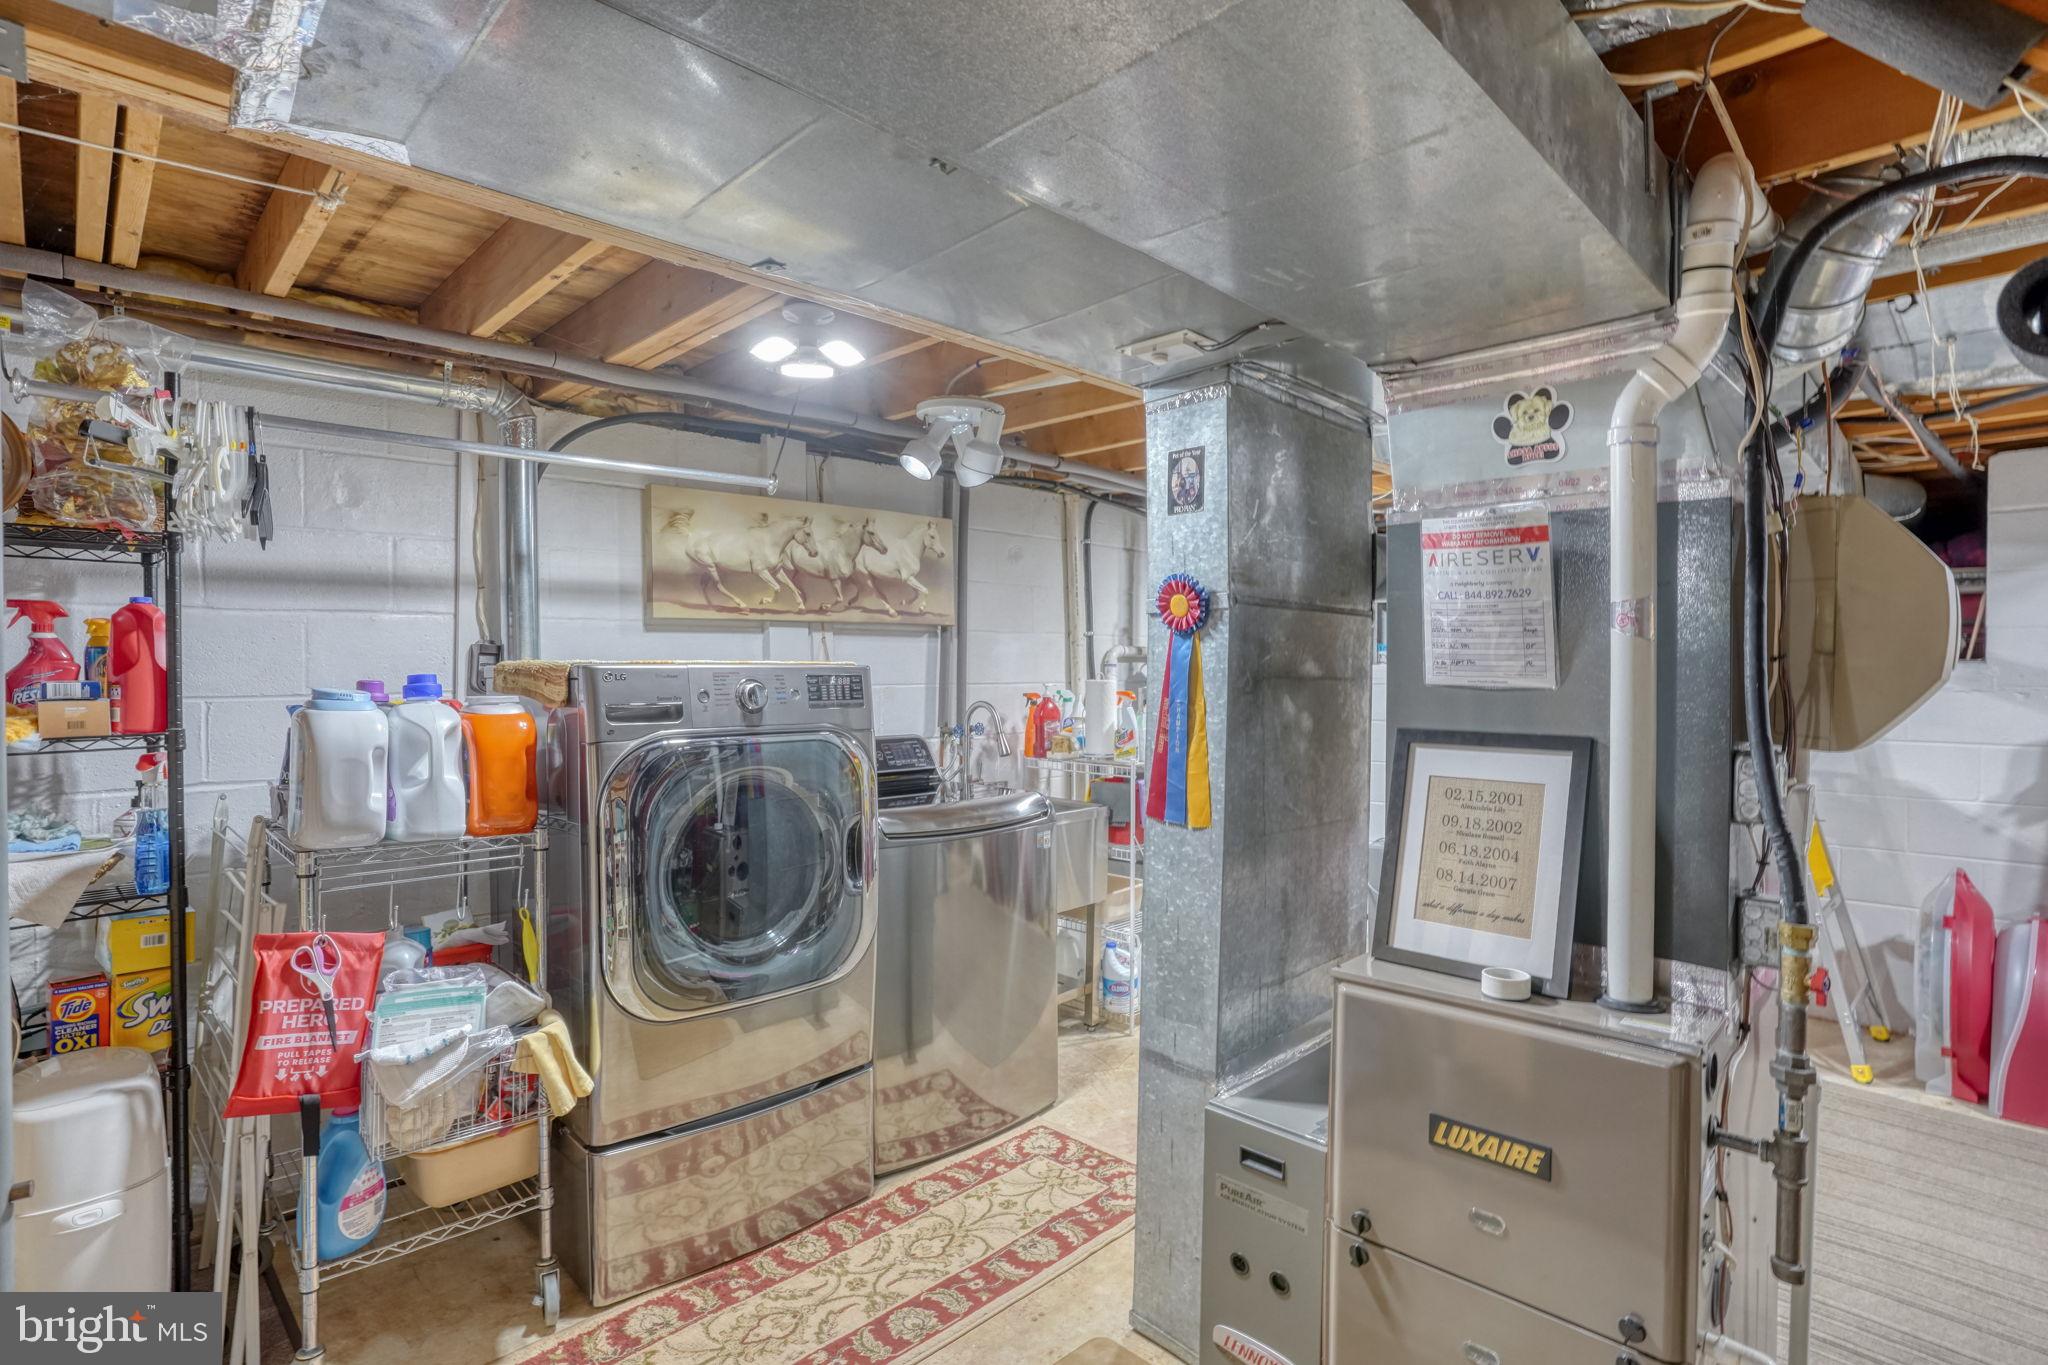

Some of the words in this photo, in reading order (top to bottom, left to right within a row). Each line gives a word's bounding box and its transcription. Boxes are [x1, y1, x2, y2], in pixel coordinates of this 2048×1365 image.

[1441, 539, 1473, 548] WARRANTY
[1474, 535, 1521, 546] INFORMATION
[1464, 588, 1532, 599] 844.892.7629
[614, 673, 627, 681] LG
[13, 690, 41, 705] RES
[1445, 787, 1525, 807] 02.15.2001
[1442, 815, 1523, 835] 09.18.2002
[1439, 841, 1520, 863] 06.18.2004
[1436, 867, 1518, 891] 08.14.2007
[61, 999, 92, 1019] Tide
[55, 1023, 97, 1036] CLEANER
[54, 1034, 98, 1053] OXI
[292, 1057, 331, 1065] RELEASE
[1433, 1121, 1546, 1175] LUXAIRE
[1278, 1216, 1305, 1233] SYSTEM
